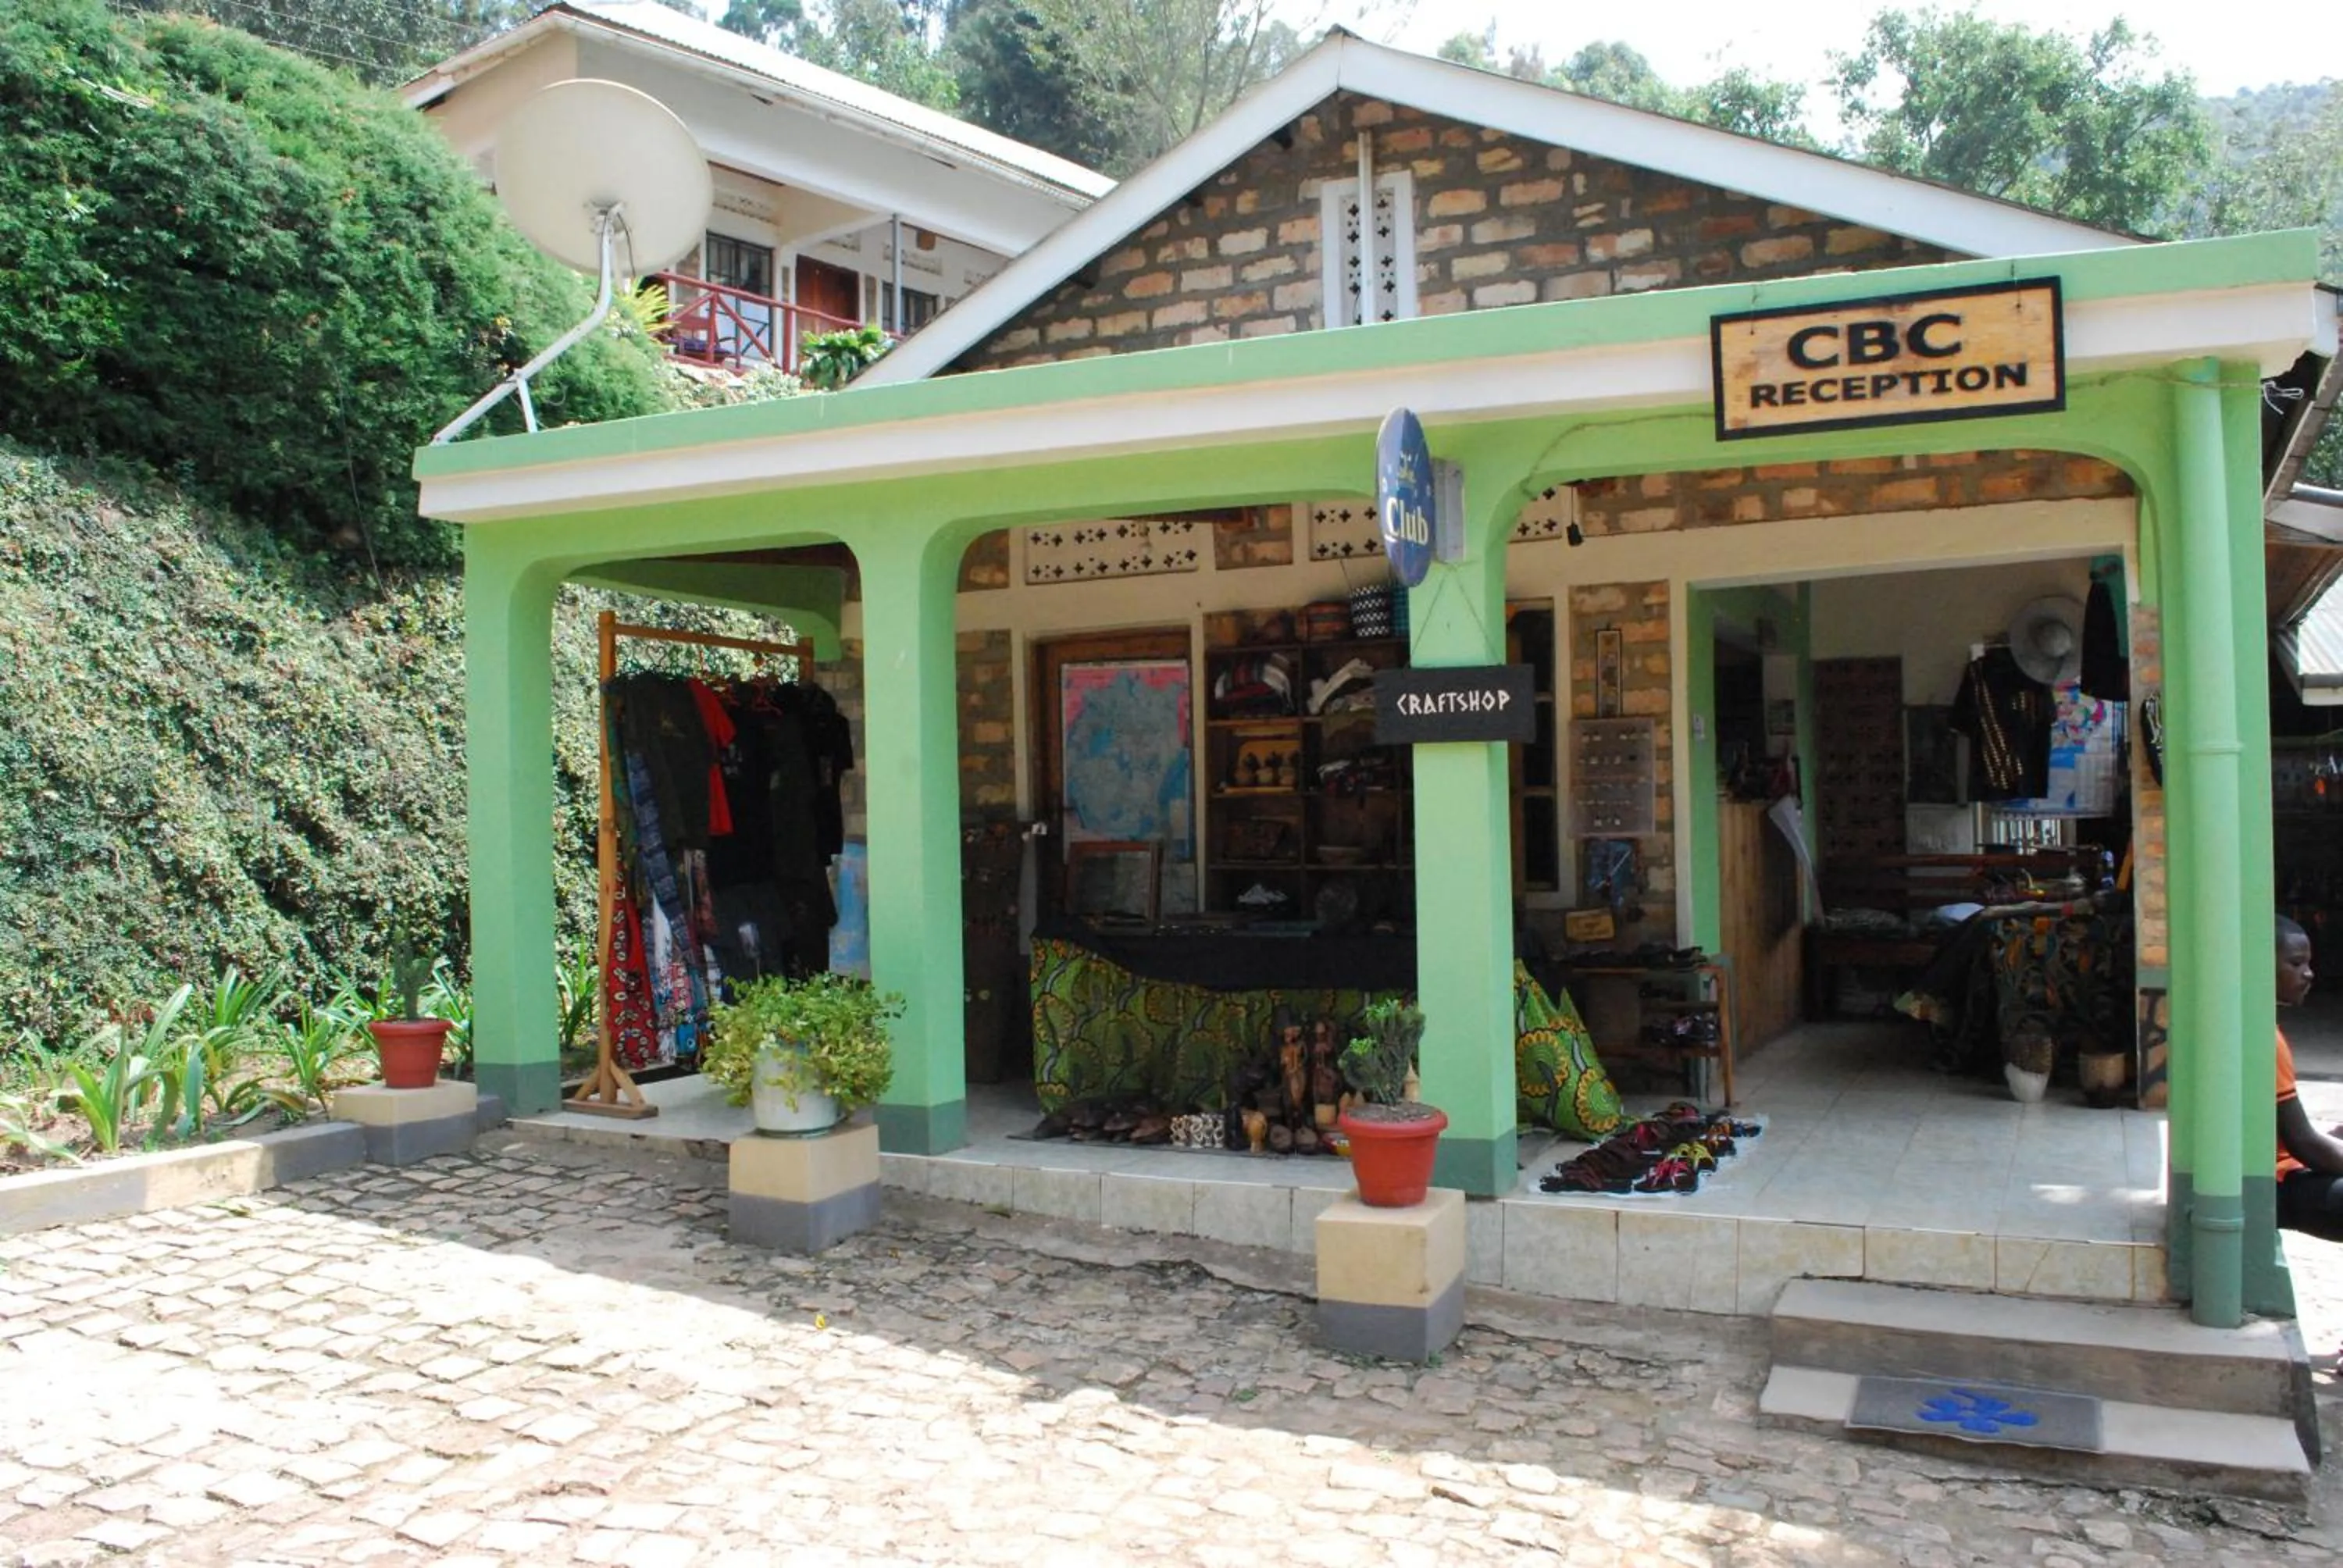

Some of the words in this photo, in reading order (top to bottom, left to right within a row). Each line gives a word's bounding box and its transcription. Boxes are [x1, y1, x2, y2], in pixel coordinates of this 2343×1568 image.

[1787, 314, 1963, 369] CBC
[1750, 362, 2027, 408] RECEPTION
[1385, 497, 1428, 546] Club
[1396, 690, 1510, 716] CRAFTSHOP
